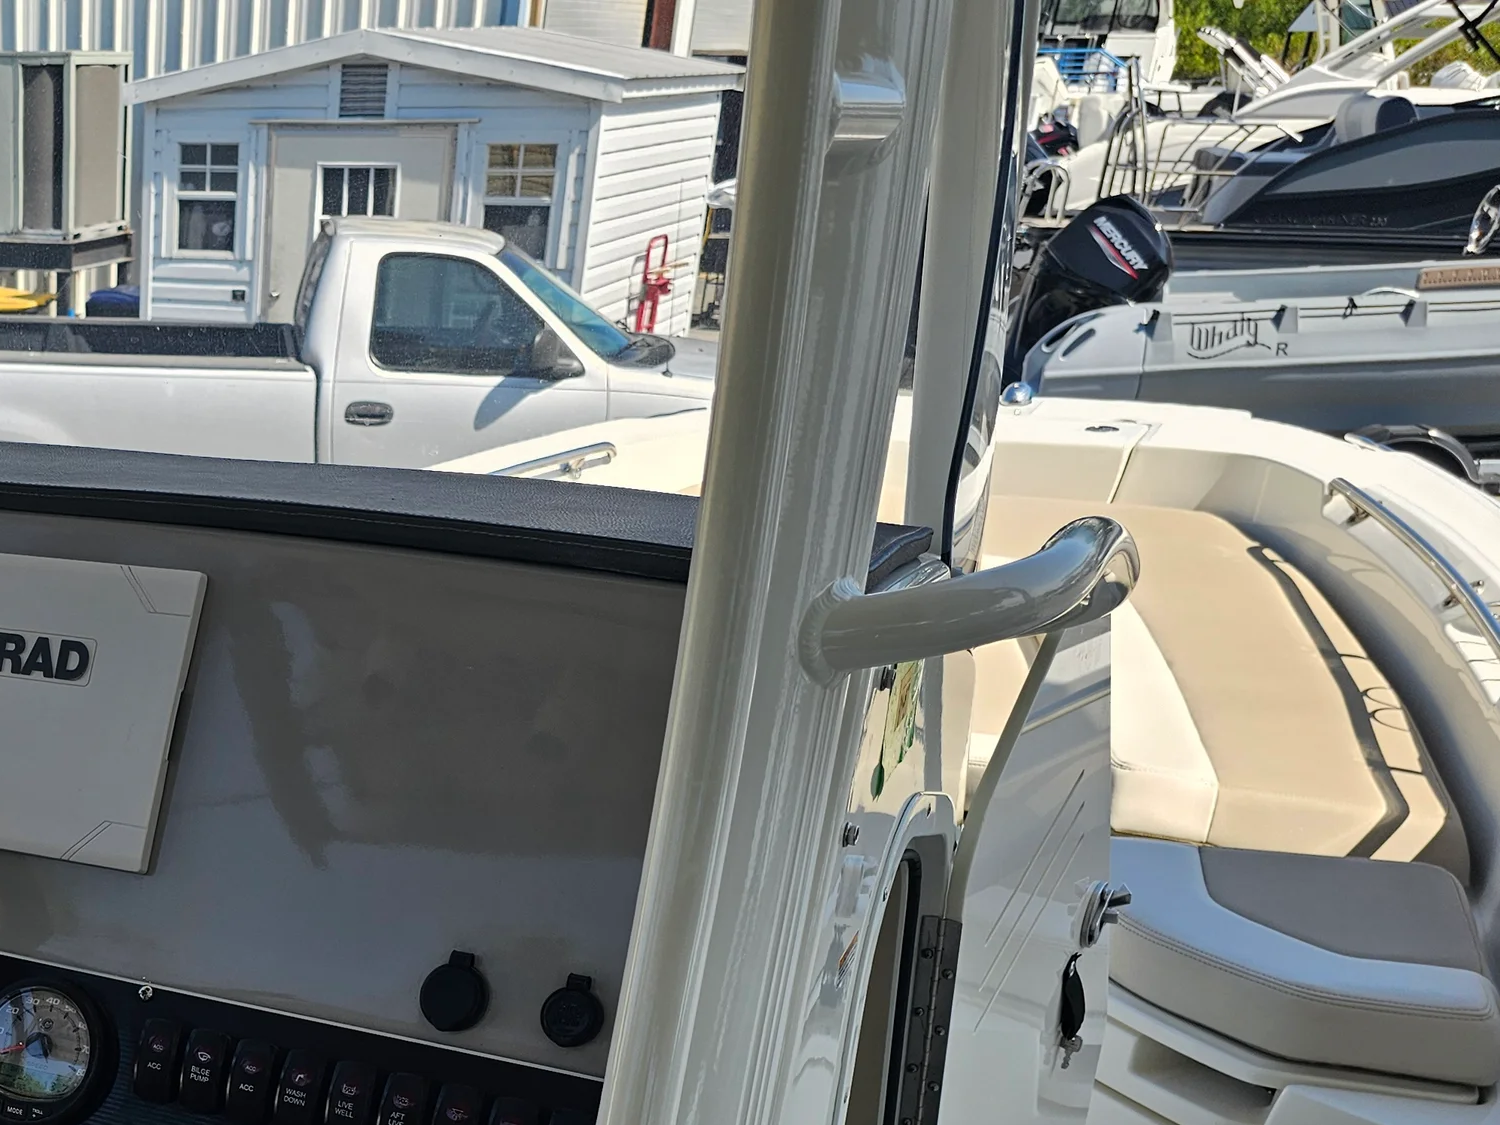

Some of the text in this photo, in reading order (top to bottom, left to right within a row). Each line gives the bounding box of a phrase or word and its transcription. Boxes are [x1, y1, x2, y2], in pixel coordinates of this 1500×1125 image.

[1093, 216, 1148, 270] MERCURY
[6, 1005, 19, 1014] 20
[147, 1061, 161, 1070] ACC
[190, 1065, 210, 1076] BILGE
[189, 1072, 209, 1082] PUMP
[238, 1083, 254, 1092] ACC
[285, 1087, 306, 1098] WASH
[283, 1096, 305, 1106] DOWN
[337, 1100, 353, 1110] LIVE
[7, 1105, 22, 1115] MODE
[334, 1107, 353, 1118] WELL
[390, 1111, 405, 1120] AFT
